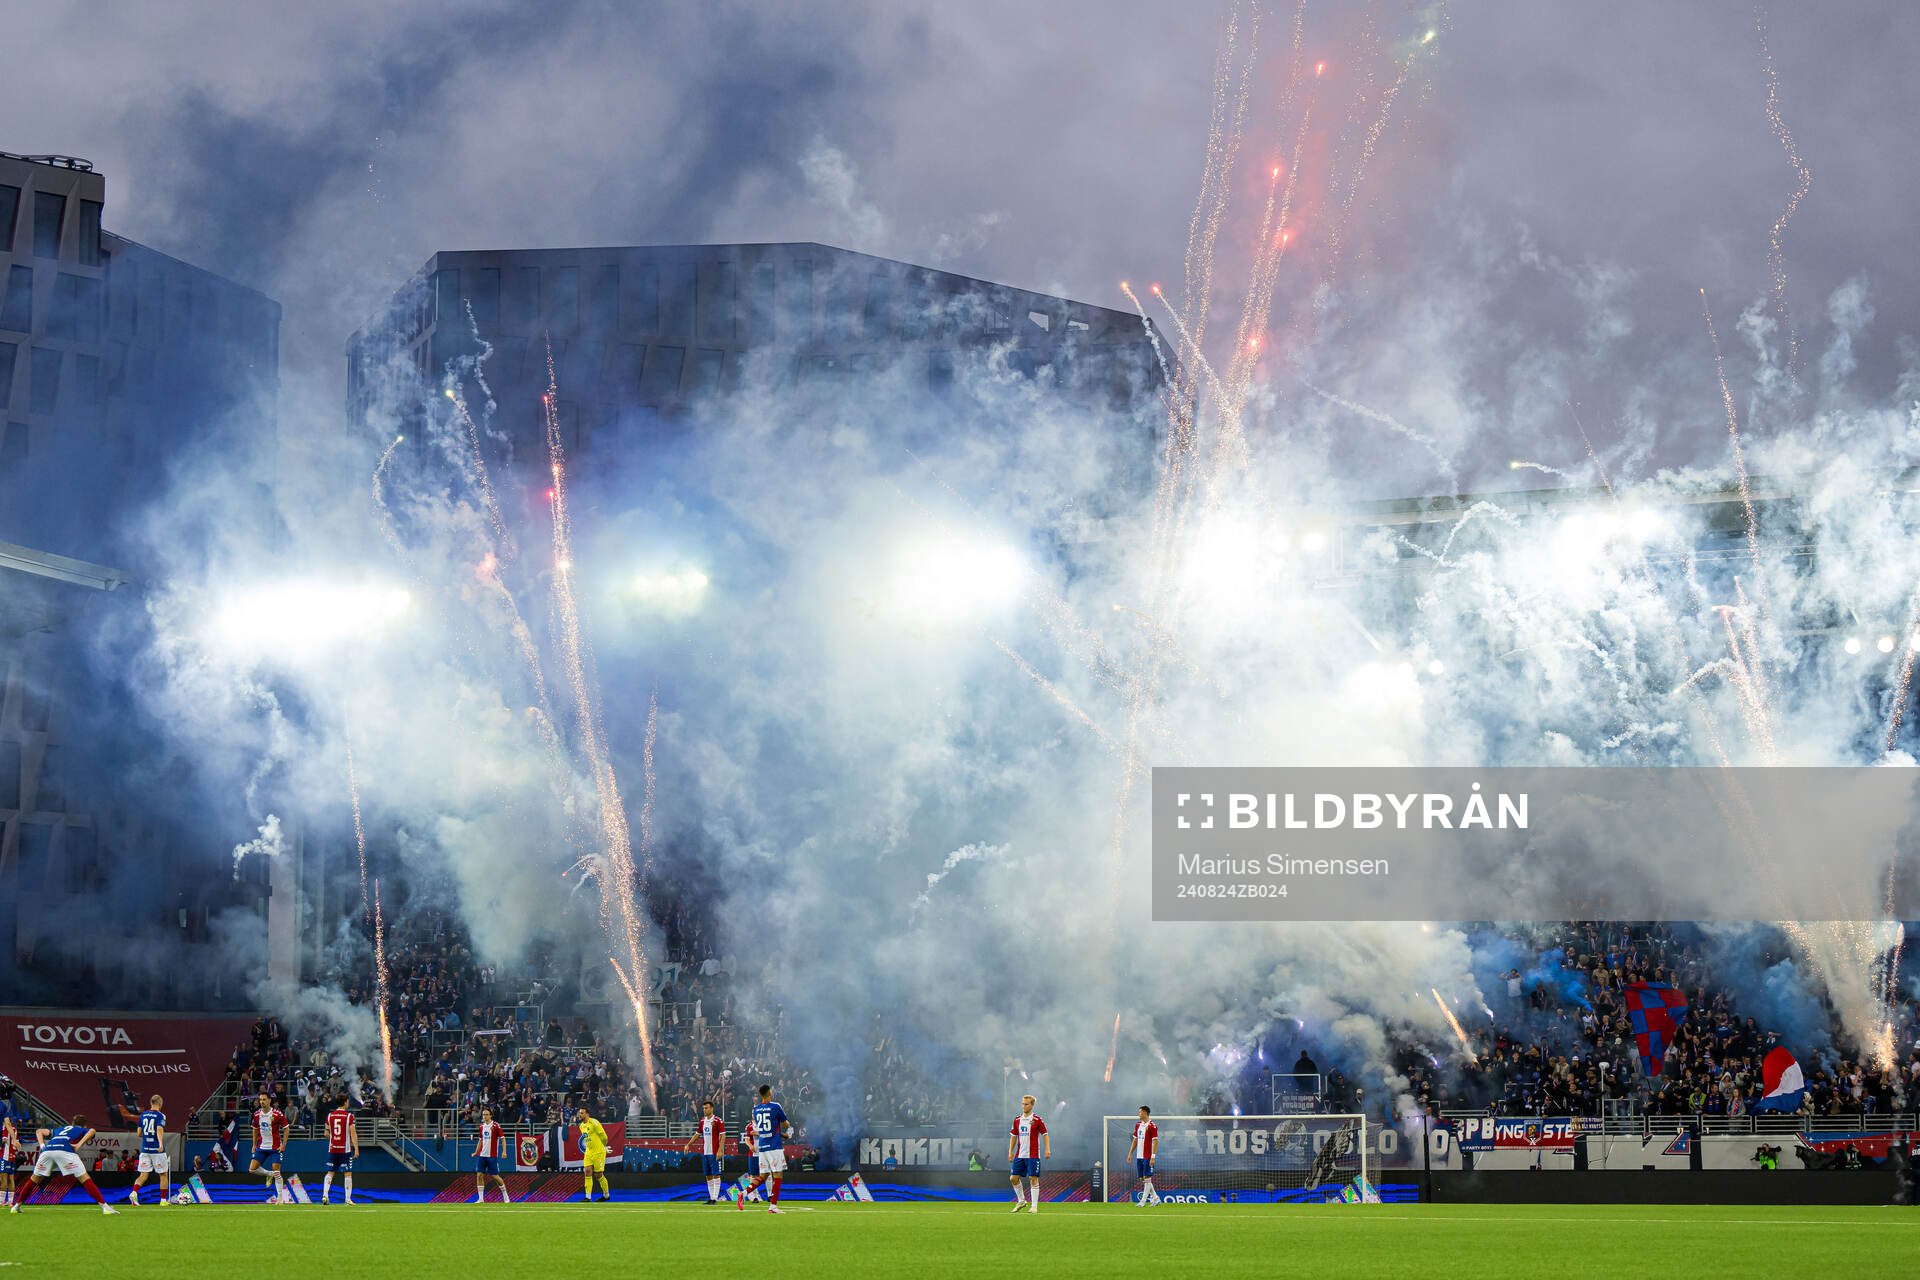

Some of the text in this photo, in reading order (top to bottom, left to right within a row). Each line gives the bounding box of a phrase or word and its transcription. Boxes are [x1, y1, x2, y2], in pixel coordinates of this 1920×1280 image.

[17, 1024, 133, 1045] TOYOTA
[25, 1059, 191, 1075] MATERIAL HANDLING
[142, 1118, 155, 1135] 24
[333, 1118, 342, 1135] 5
[756, 1113, 771, 1131] 25
[58, 1126, 74, 1136] 2
[85, 1138, 120, 1147] OYOTA
